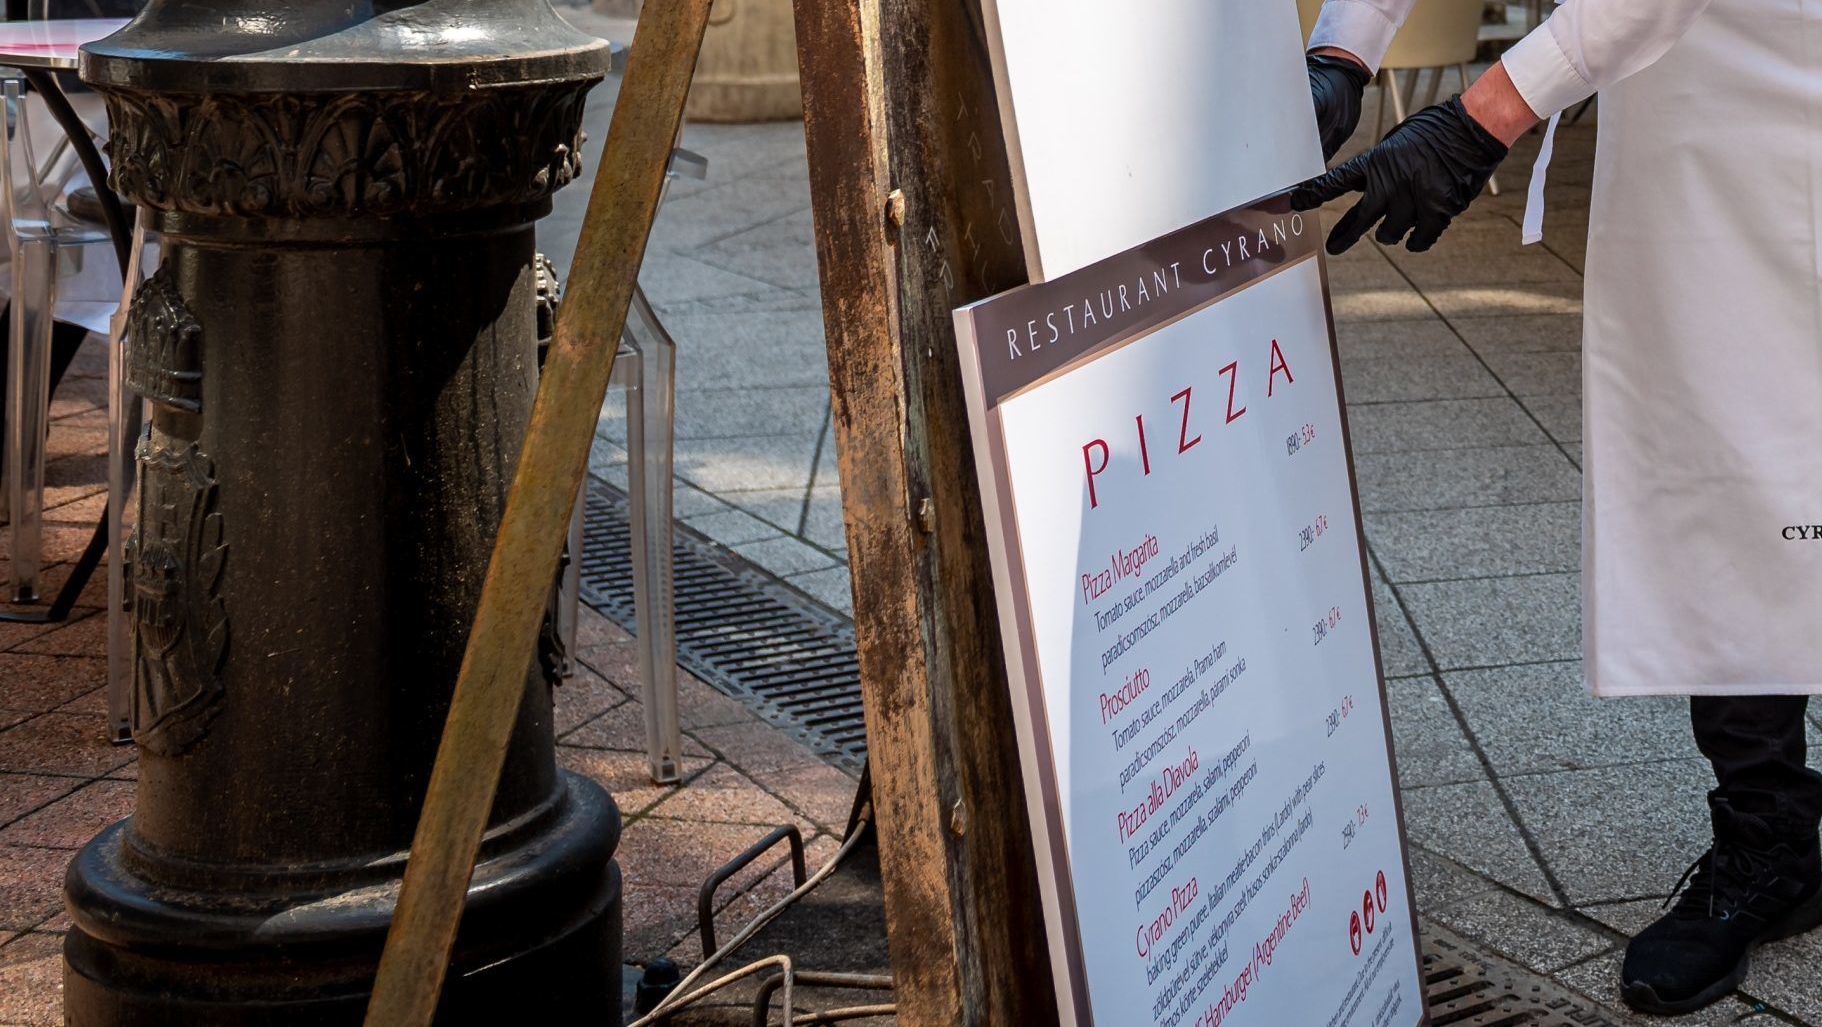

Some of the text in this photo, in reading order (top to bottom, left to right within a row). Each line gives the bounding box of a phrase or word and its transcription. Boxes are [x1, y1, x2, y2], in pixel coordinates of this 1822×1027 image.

[1006, 213, 1304, 360] RESTAURANT CYRANO
[1081, 338, 1294, 510] PIZZA
[1081, 534, 1159, 605] Pizza Margarita
[1093, 524, 1219, 633] Tomato sauce, mozzarella and fresh basil
[1099, 668, 1150, 725] Prosciutto
[1111, 718, 1141, 752] Tomato
[1141, 700, 1162, 729] sauce,
[1212, 641, 1226, 663] ham
[1229, 656, 1246, 683] sonka
[1117, 745, 1199, 845] Pizza alla Diavola
[1128, 840, 1150, 871] Pizza
[1149, 819, 1171, 850] sauce,
[1203, 759, 1223, 794] salami,
[1222, 729, 1250, 779] pepperoni
[1230, 757, 1258, 808] pepperoni
[1136, 877, 1198, 962] Cyrano Pizza
[1146, 947, 1172, 987] baking
[1170, 926, 1190, 964] green
[1207, 882, 1227, 912] Italian
[1292, 785, 1303, 809] with
[1301, 775, 1313, 802] pear
[1311, 760, 1325, 784] slices
[1204, 876, 1311, 1027] Hamburger (Argentine Beef)
